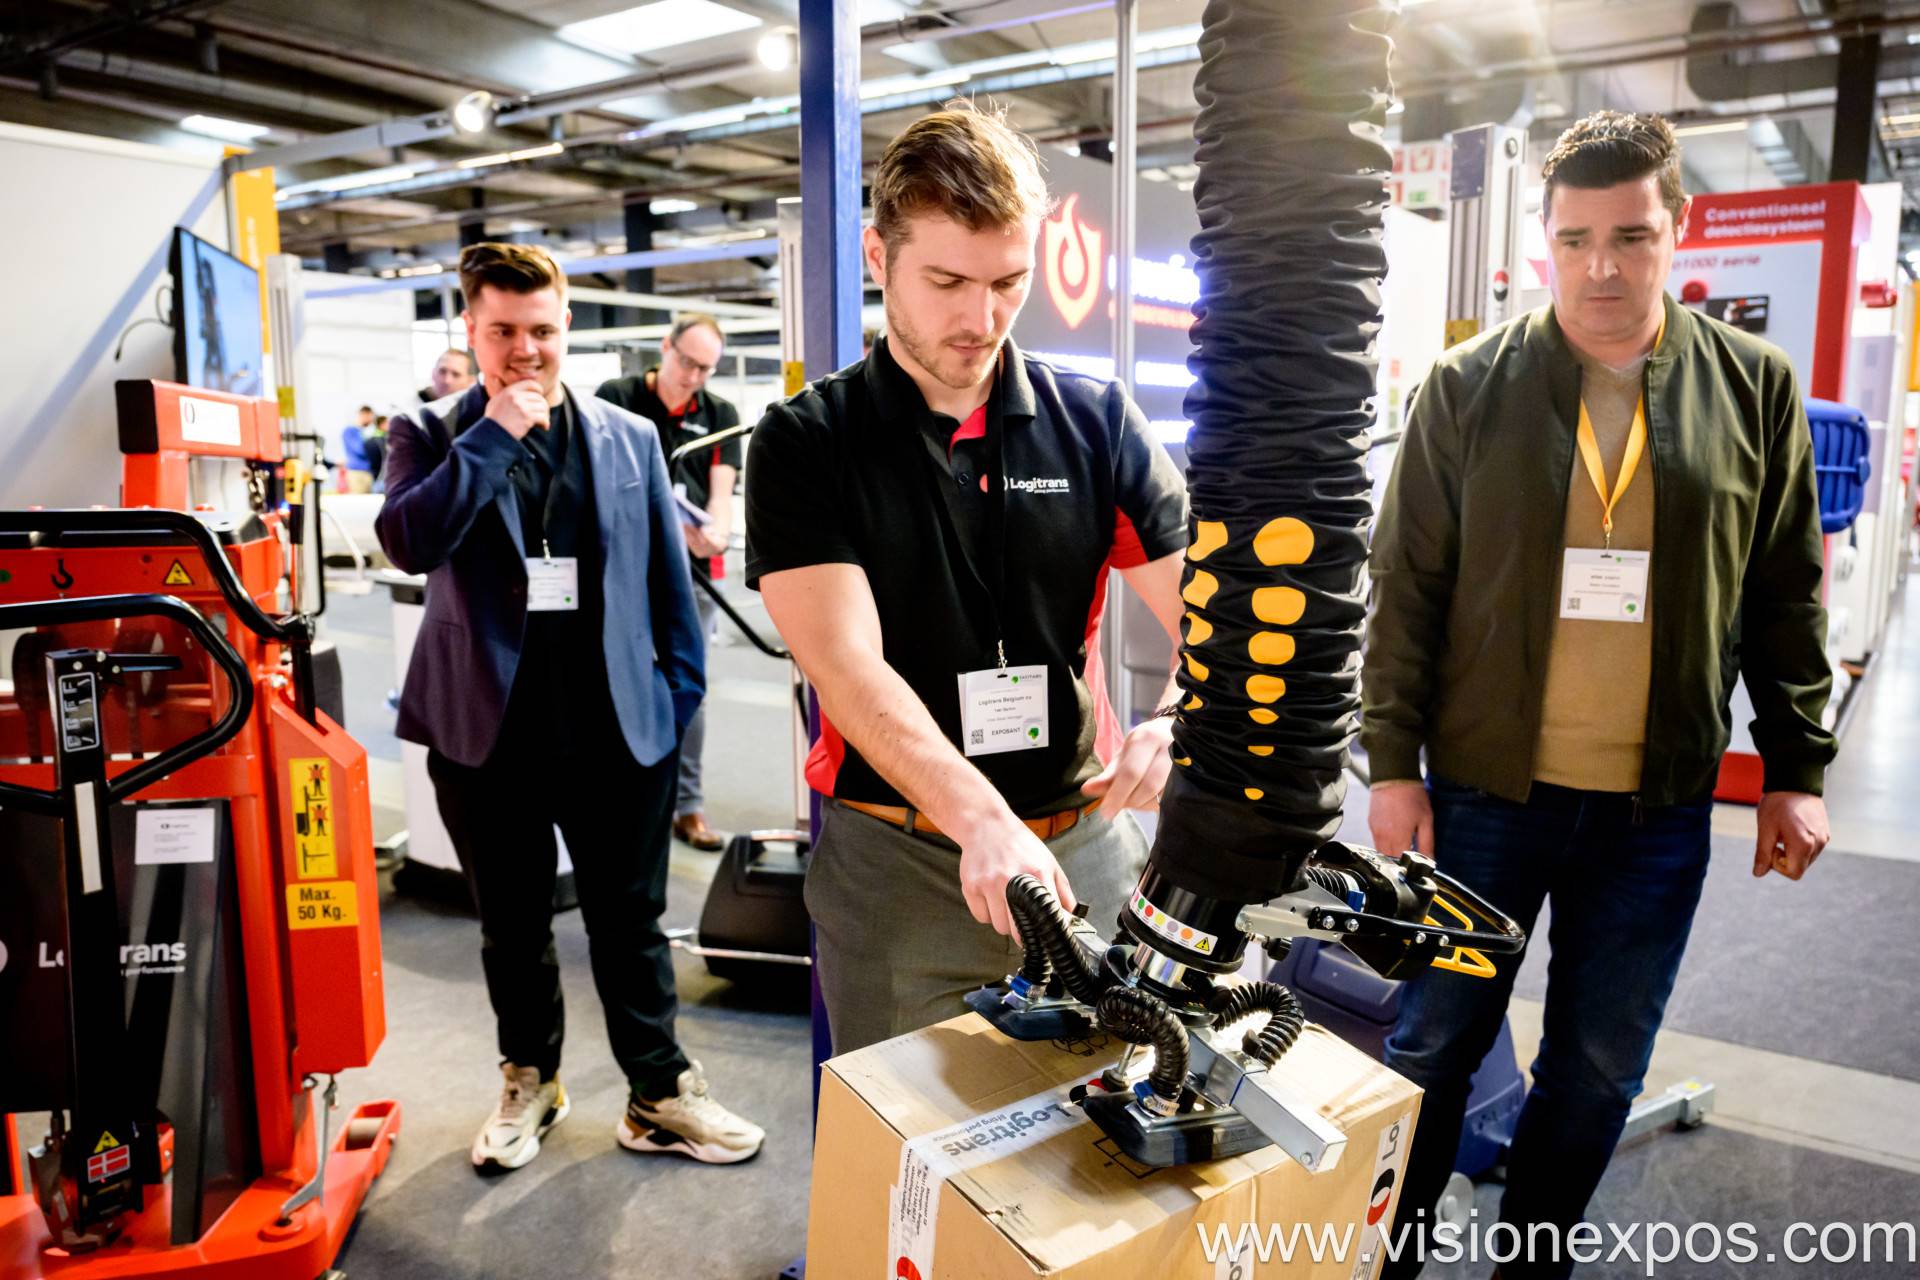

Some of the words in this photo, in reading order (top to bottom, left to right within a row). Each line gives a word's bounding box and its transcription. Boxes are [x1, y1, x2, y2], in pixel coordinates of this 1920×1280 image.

[1009, 477, 1069, 492] Logitrans
[991, 727, 1021, 736] EXPOSANT
[300, 887, 337, 902] Max.
[298, 905, 316, 920] 50
[322, 905, 347, 921] Kg.
[942, 1103, 1072, 1156] Logitrans
